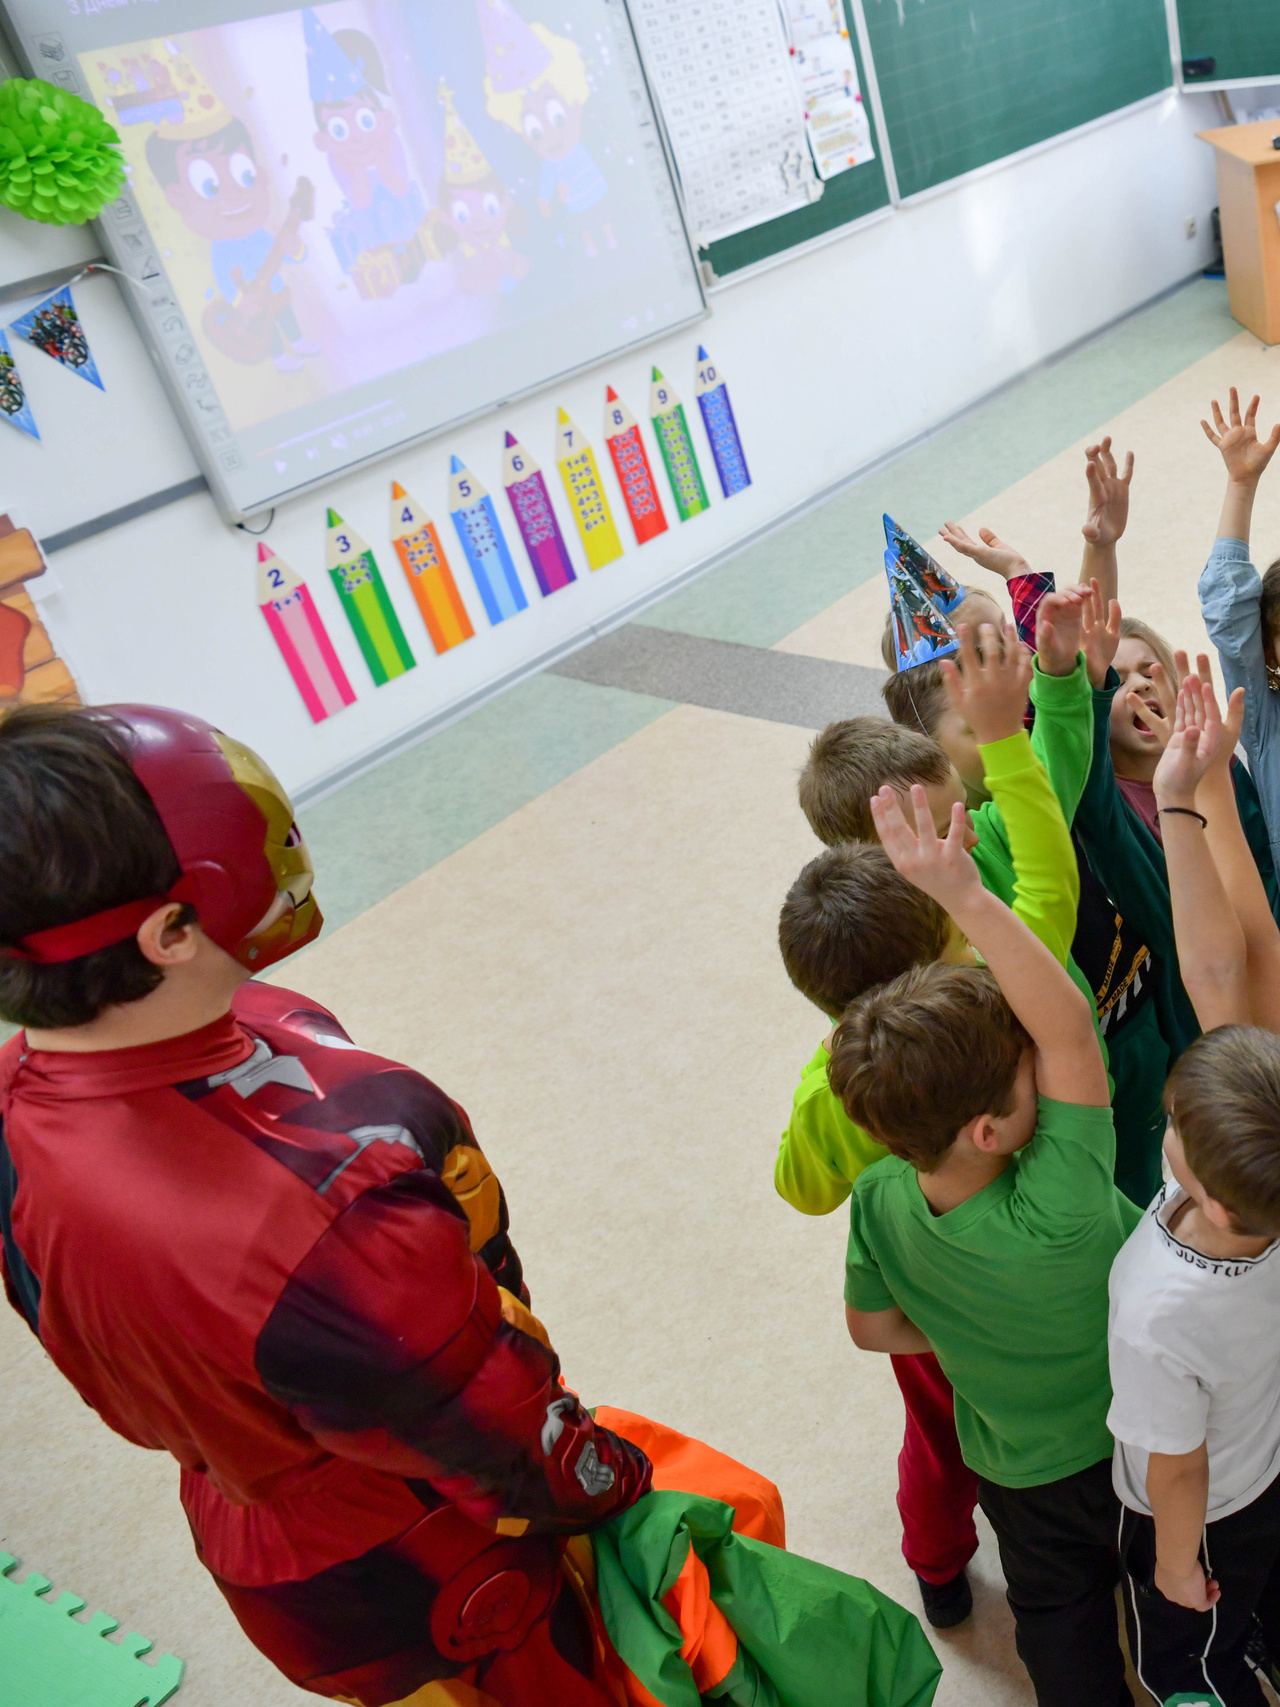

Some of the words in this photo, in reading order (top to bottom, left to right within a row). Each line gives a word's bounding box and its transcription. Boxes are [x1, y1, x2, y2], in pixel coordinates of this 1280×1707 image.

[699, 366, 717, 384] 10
[657, 389, 668, 404] 9
[612, 409, 623, 425] 8
[563, 430, 573, 448] 7
[511, 455, 524, 472] 6
[458, 480, 471, 498] 5
[401, 506, 414, 522] 4
[336, 535, 351, 553] 3
[267, 569, 284, 588] 2
